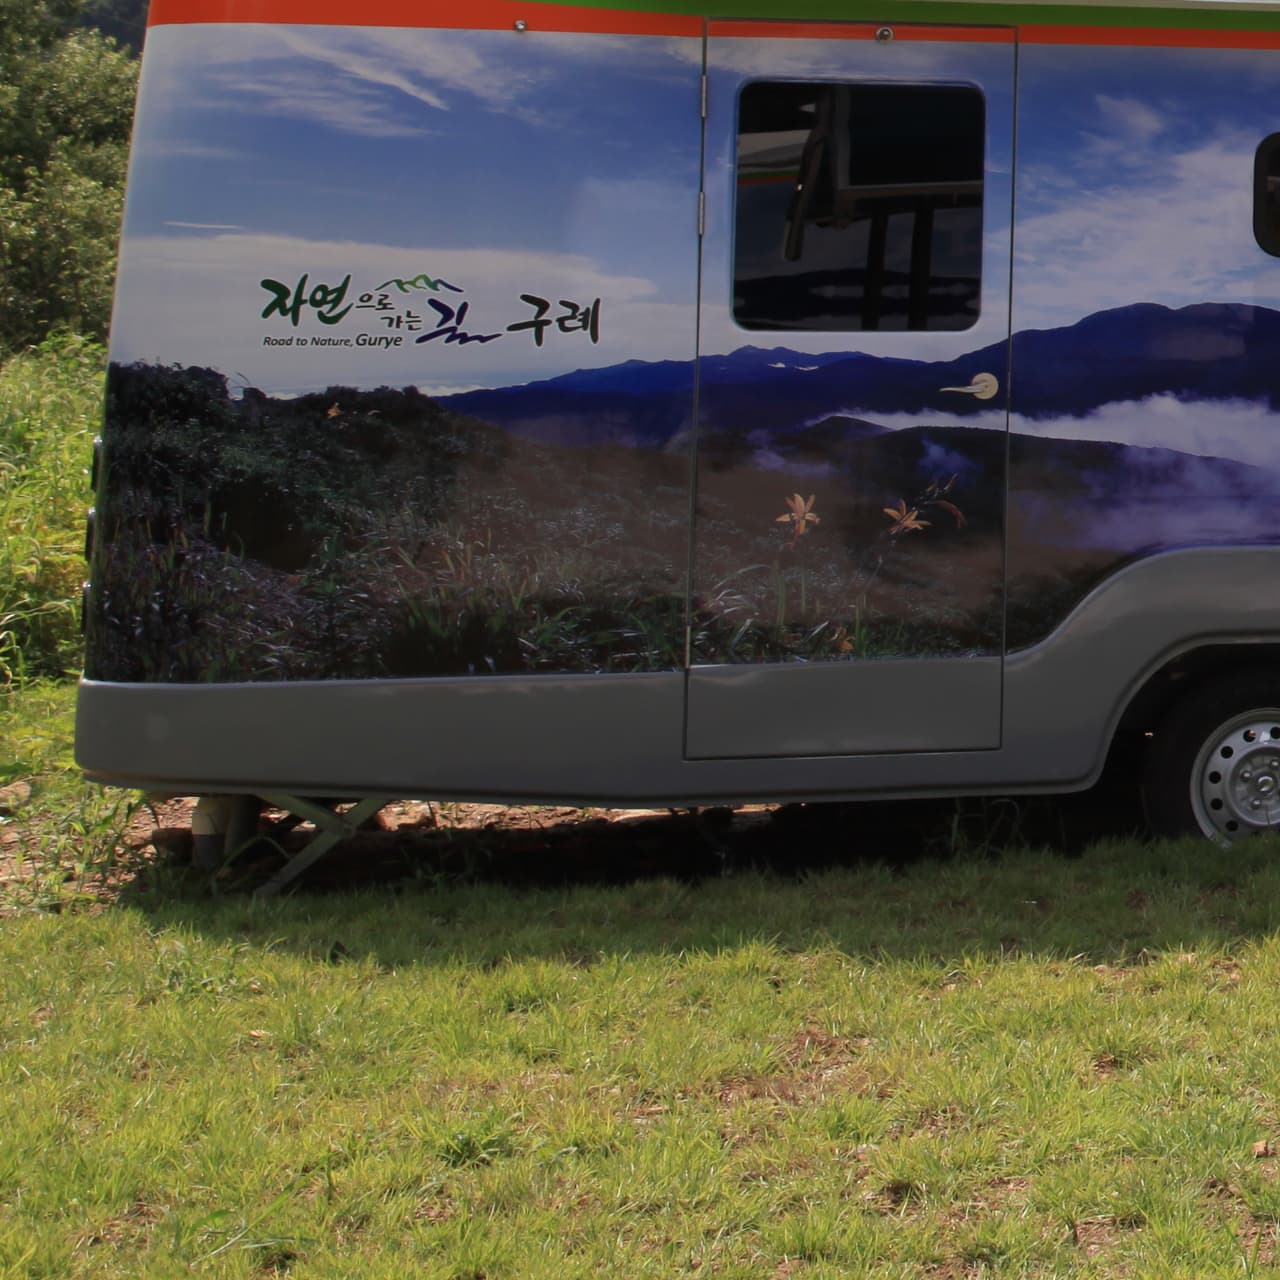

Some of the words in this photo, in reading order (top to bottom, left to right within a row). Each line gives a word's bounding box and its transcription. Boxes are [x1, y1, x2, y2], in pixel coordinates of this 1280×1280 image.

[507, 294, 601, 346] 구례
[263, 336, 293, 347] Road
[296, 337, 307, 347] to
[310, 337, 353, 348] Nature,
[355, 333, 402, 349] Gurye
